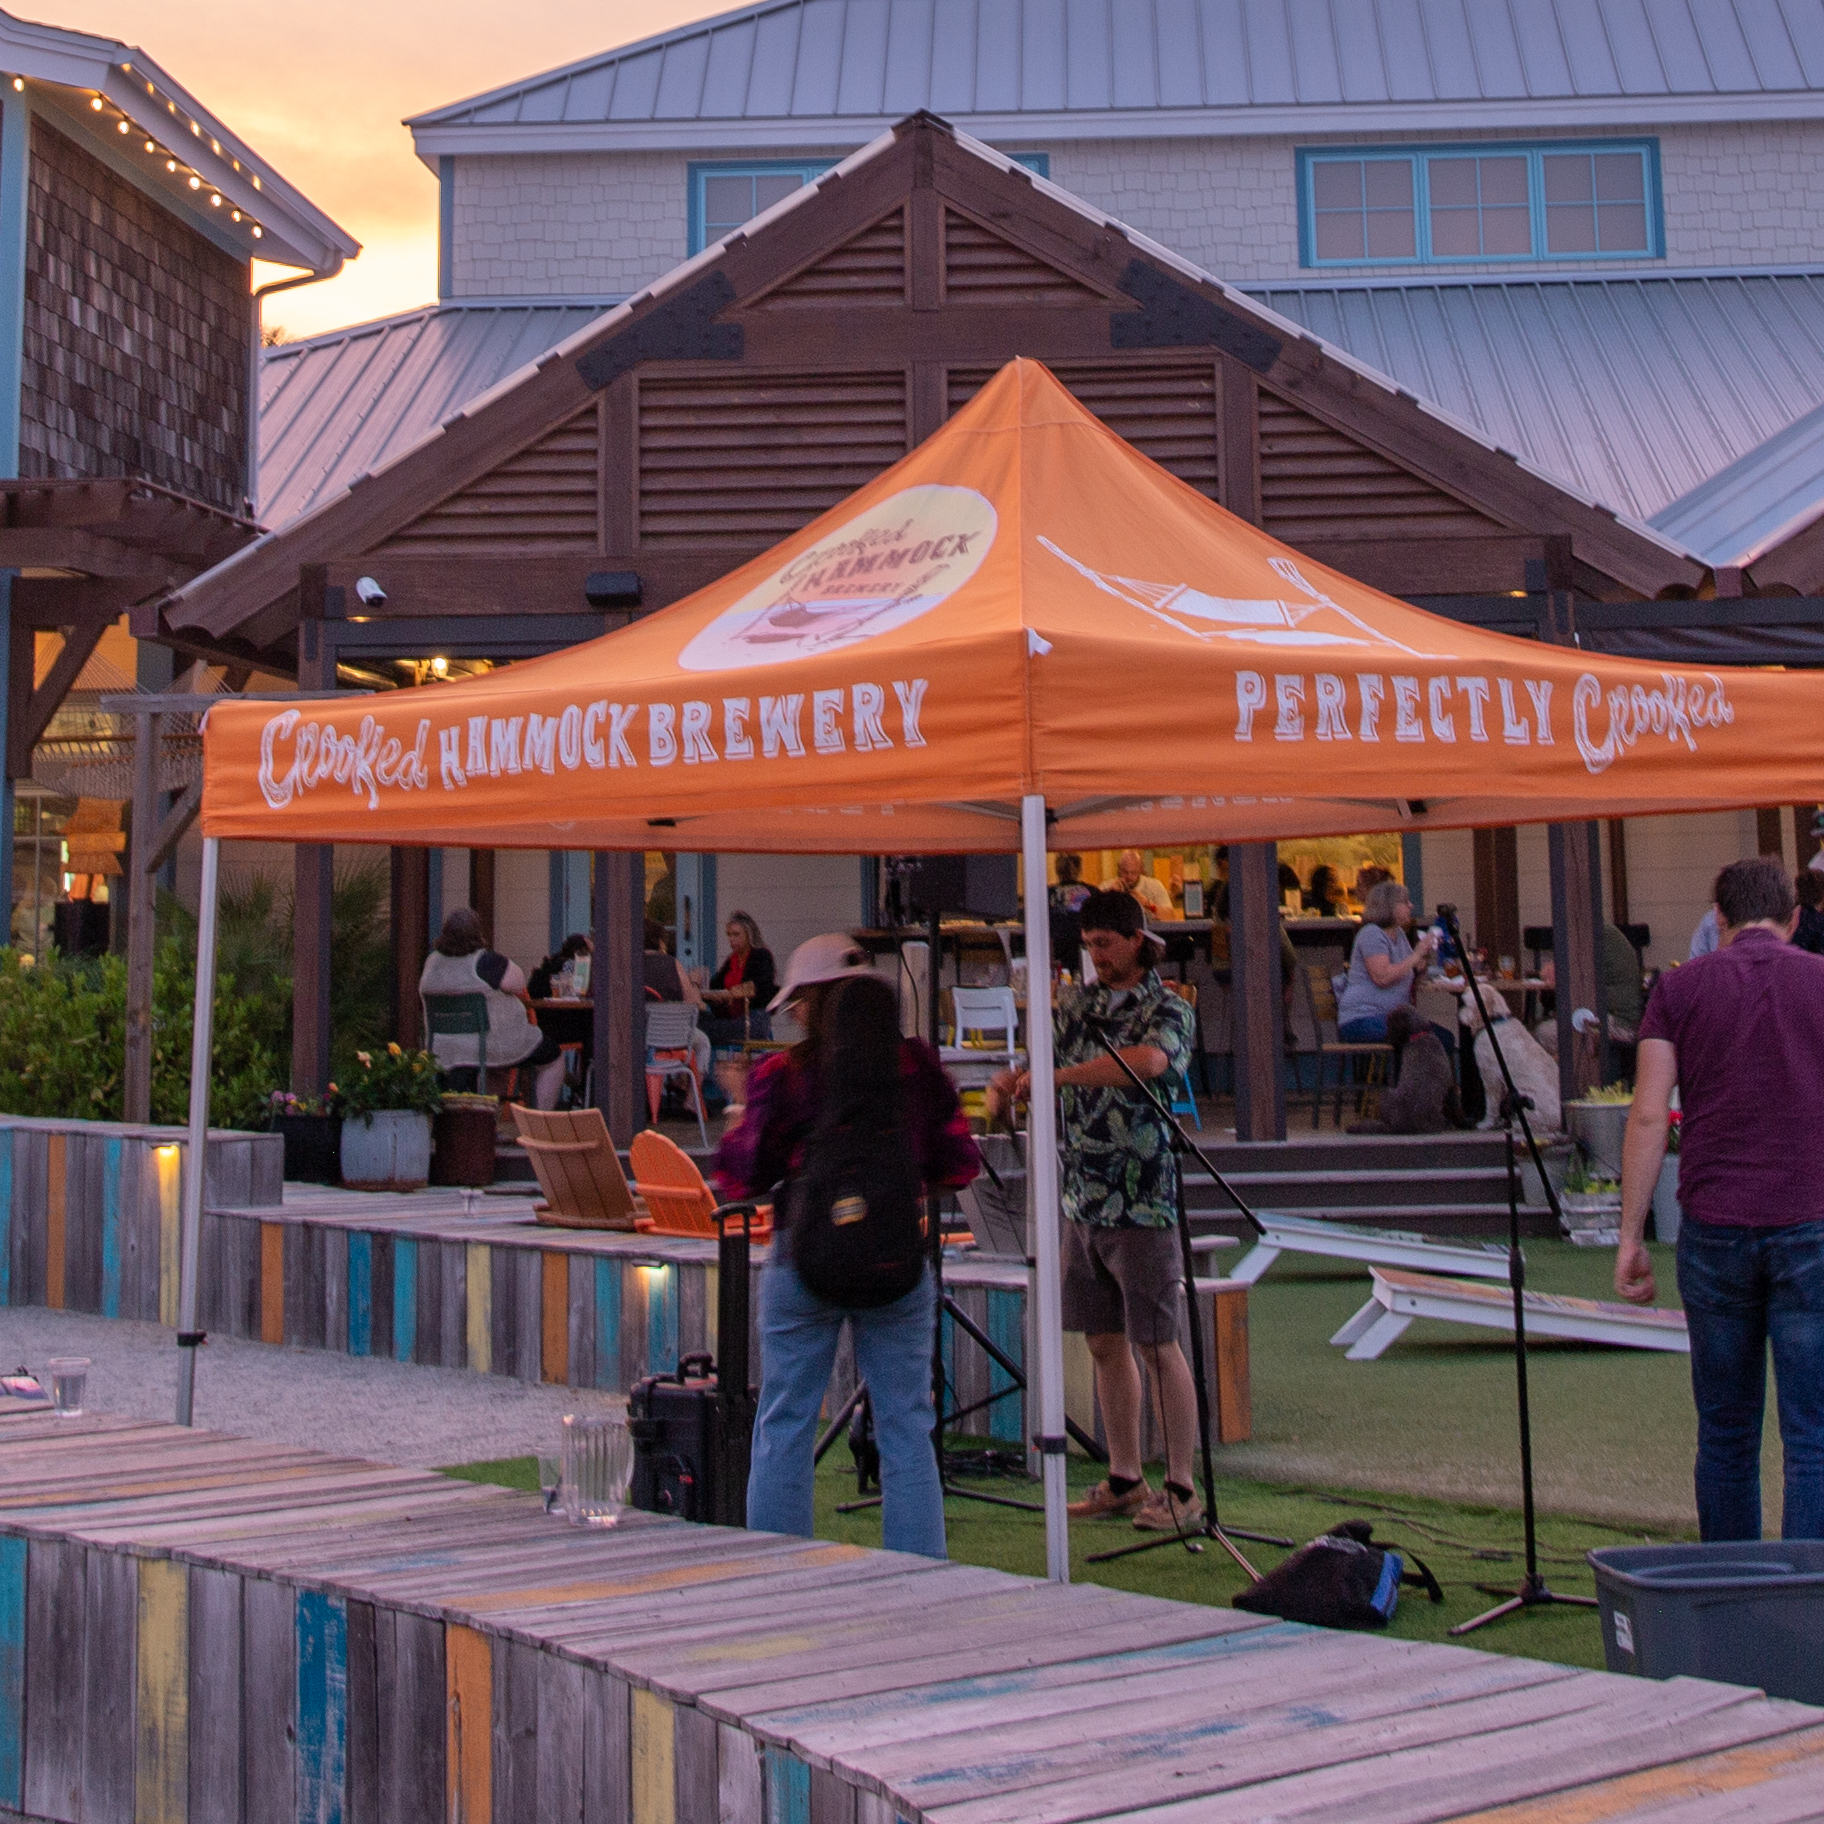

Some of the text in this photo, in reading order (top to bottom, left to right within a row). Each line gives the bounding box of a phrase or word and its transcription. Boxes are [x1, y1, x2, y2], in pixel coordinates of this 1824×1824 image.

[801, 531, 982, 592] HAMMOCK
[438, 700, 639, 791] HAMMOCK
[648, 678, 928, 766] BREWERY
[1234, 670, 1555, 745] PERFECTLY
